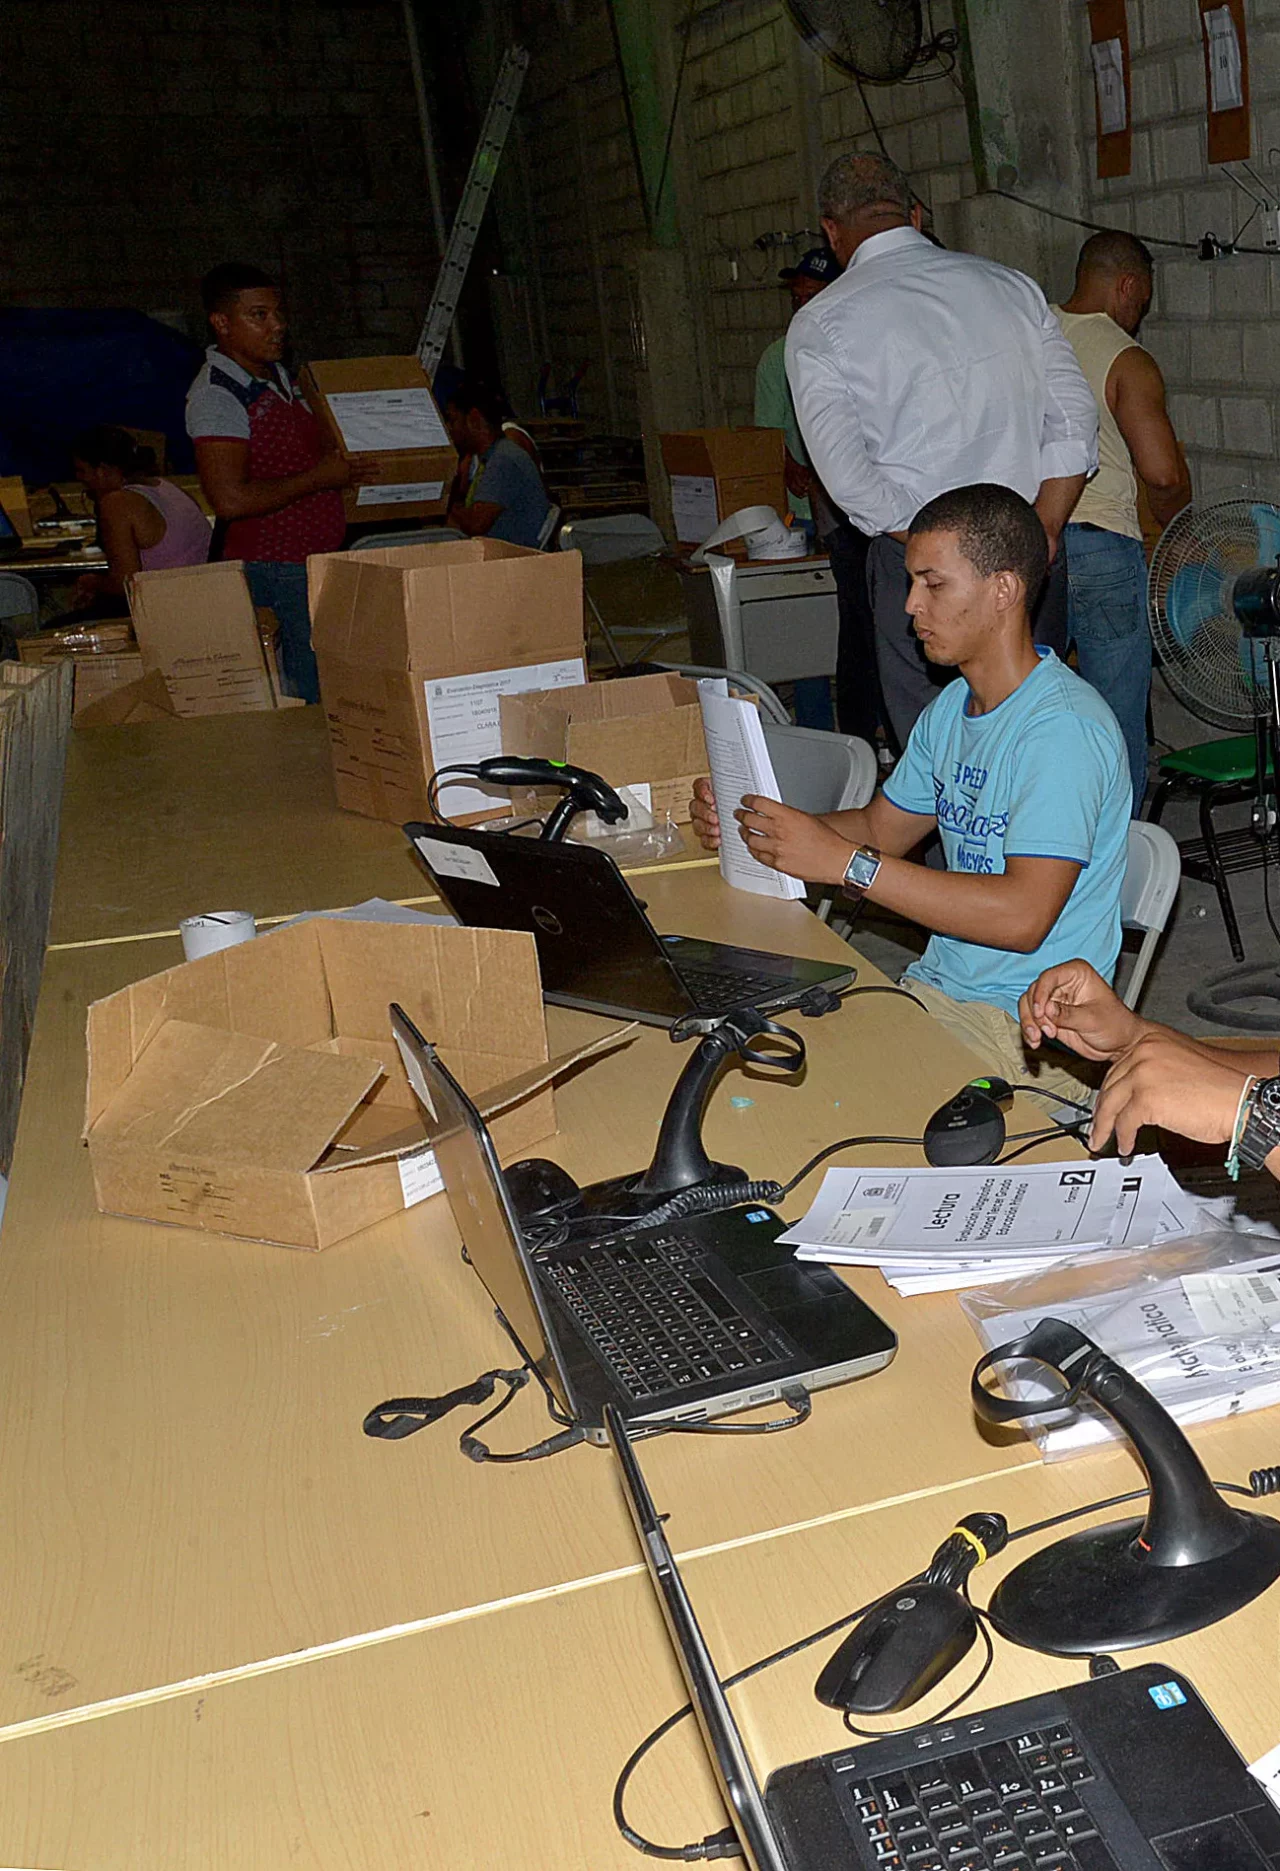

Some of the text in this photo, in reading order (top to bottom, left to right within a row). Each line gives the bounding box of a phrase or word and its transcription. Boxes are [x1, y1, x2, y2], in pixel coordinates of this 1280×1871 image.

[923, 1193, 961, 1230] Lectura
[954, 1178, 996, 1242] Evaluación Diagnóstica
[974, 1178, 1013, 1240] Nacional Tercer Grado
[996, 1182, 1029, 1236] Educación Primaria
[1064, 1186, 1080, 1204] Forma
